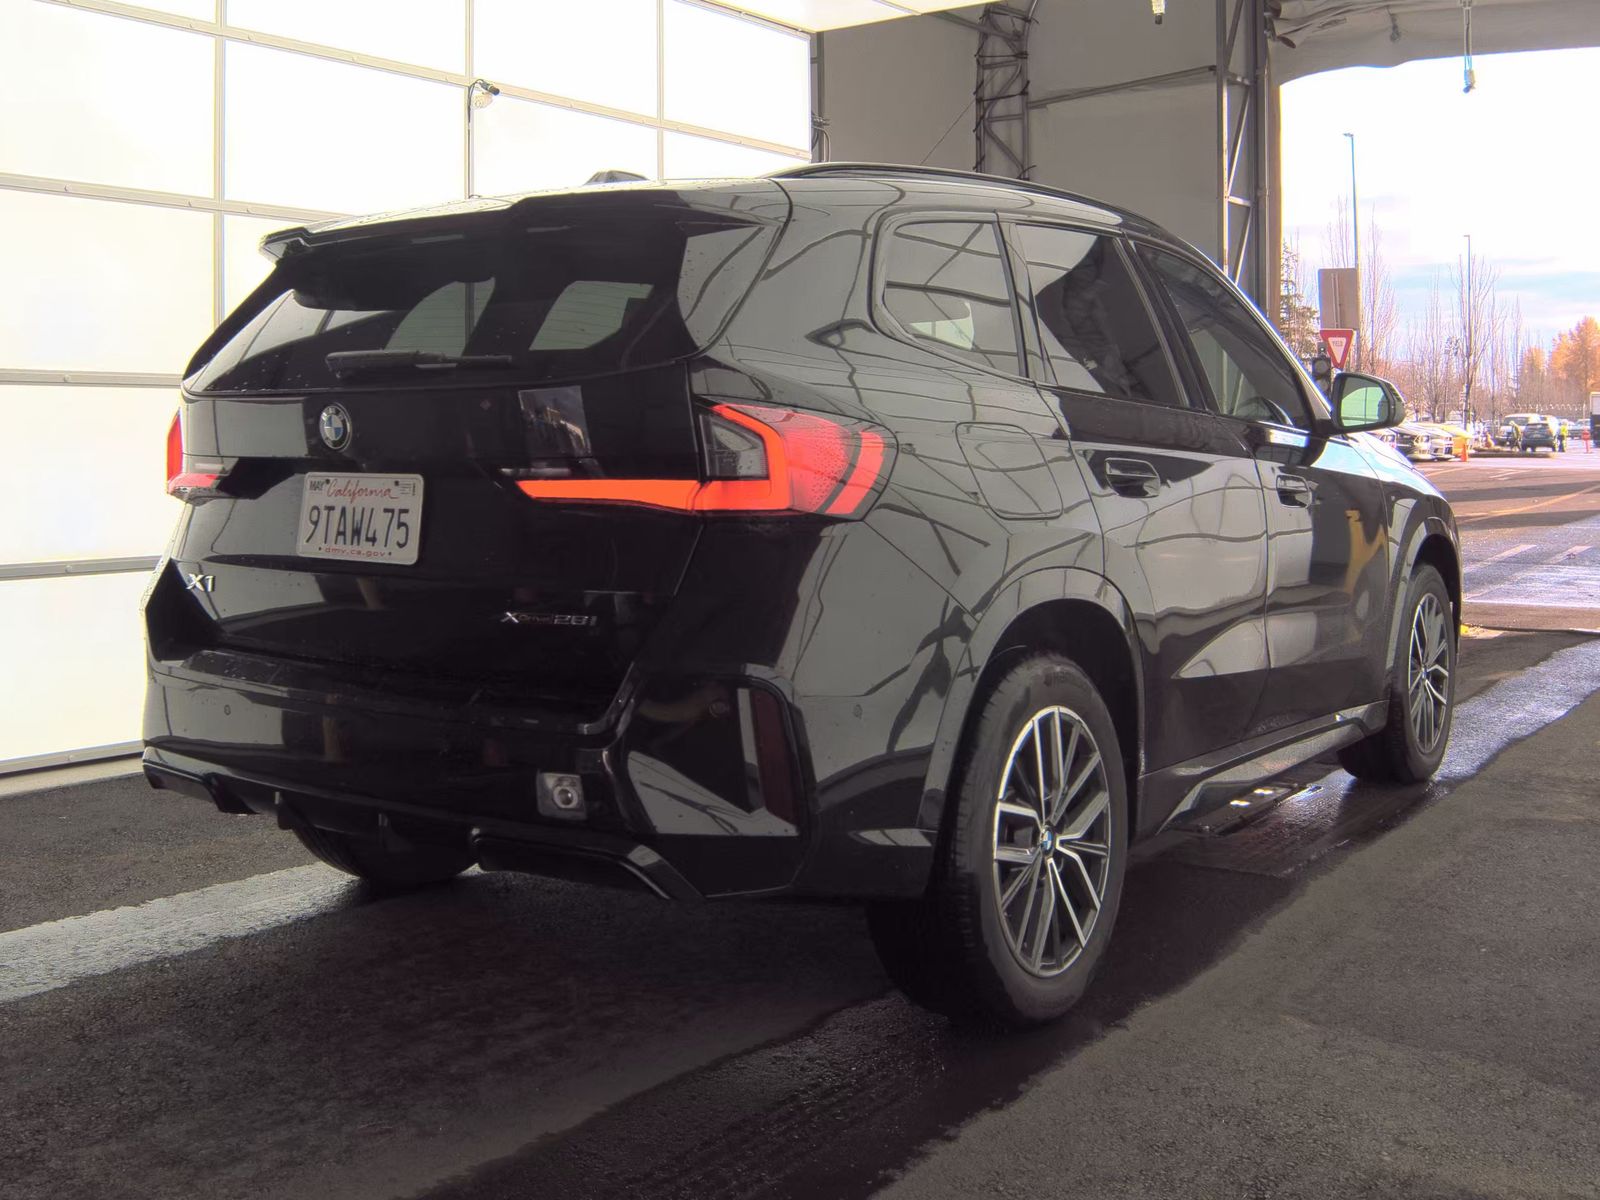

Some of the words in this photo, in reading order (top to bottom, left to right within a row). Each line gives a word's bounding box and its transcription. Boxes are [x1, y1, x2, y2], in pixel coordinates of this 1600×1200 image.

[309, 480, 325, 491] MAY
[327, 479, 399, 504] California
[305, 505, 410, 549] 9TAW475
[325, 546, 385, 557] dmv.ca.gov
[186, 573, 215, 592] X1
